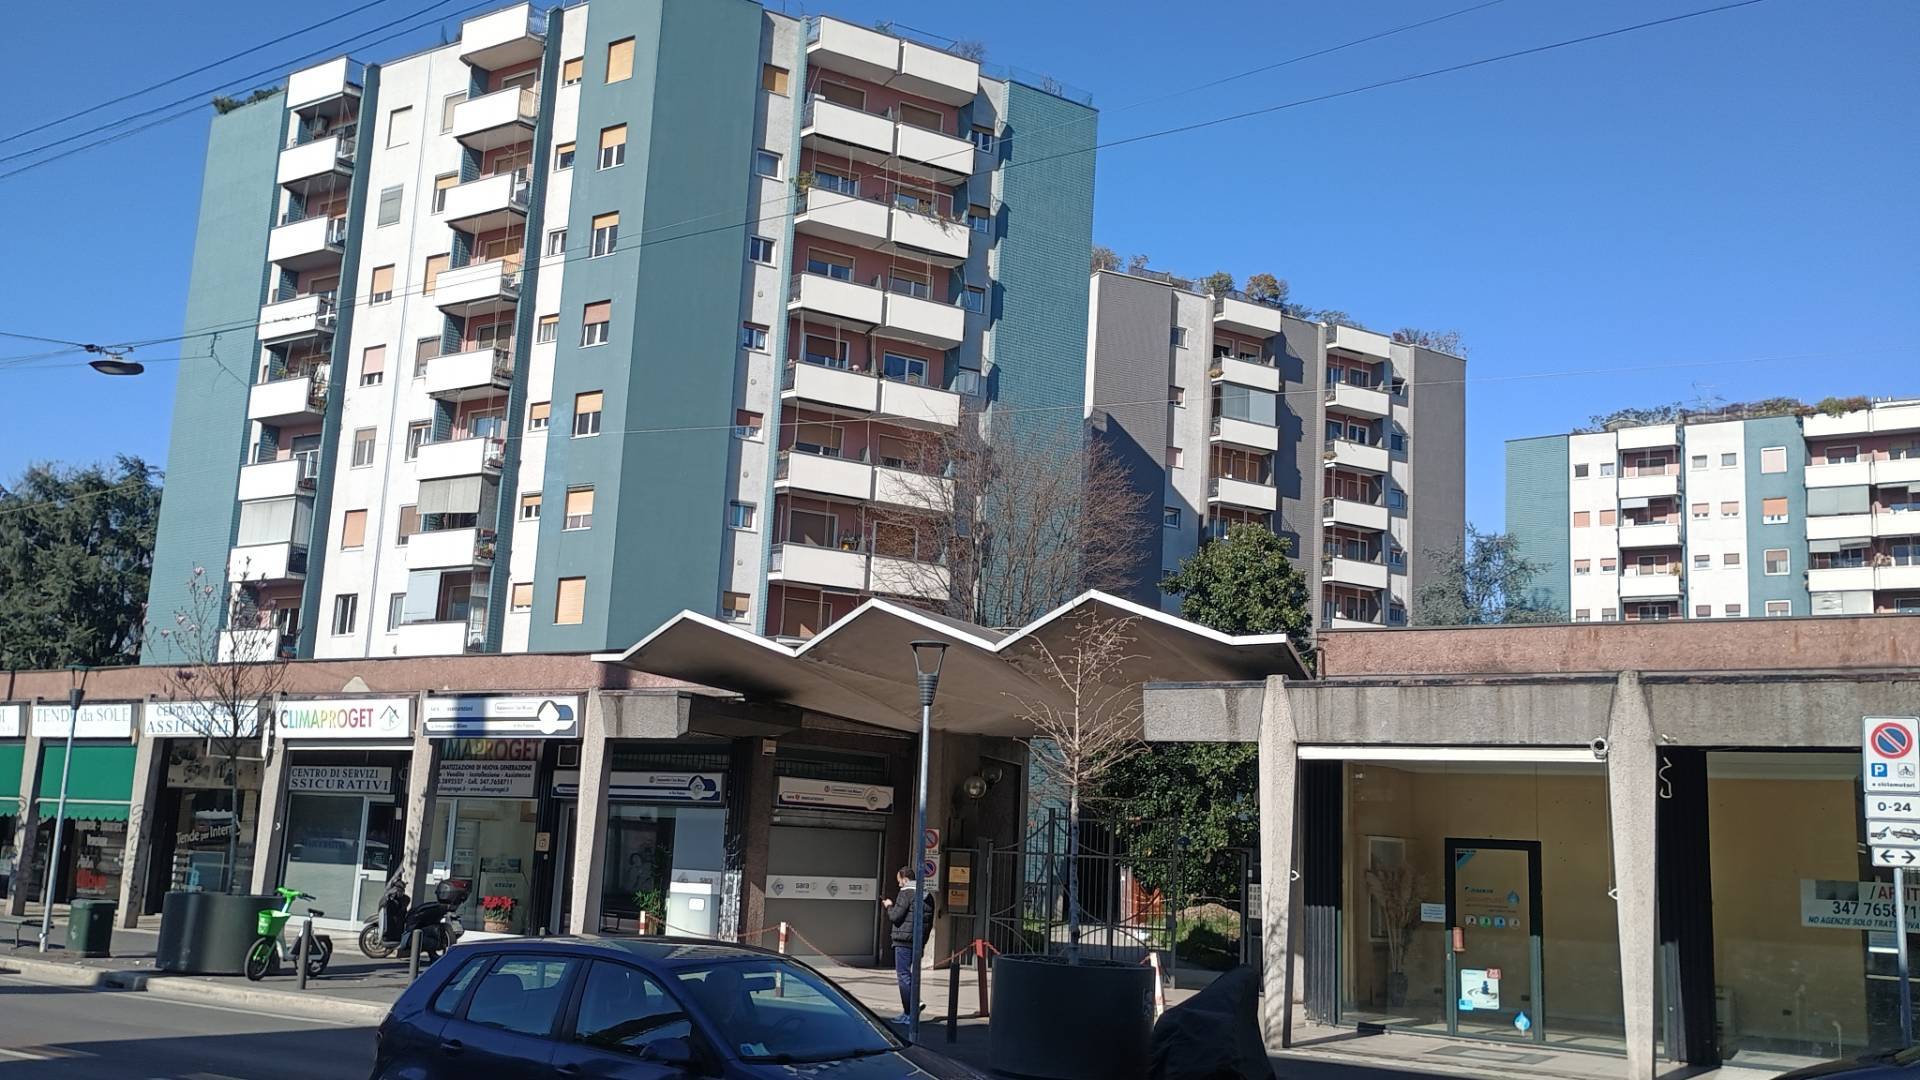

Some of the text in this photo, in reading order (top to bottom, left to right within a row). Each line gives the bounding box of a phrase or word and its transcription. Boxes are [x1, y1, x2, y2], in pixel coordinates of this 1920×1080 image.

[80, 708, 94, 721] da
[96, 707, 129, 721] SOLE
[280, 708, 374, 728] CLIMAPROGET
[291, 768, 379, 779] CENTRO DI SERVIZI
[176, 829, 200, 845] Tende
[1832, 901, 1859, 915] 347
[1808, 915, 1819, 923] NO
[1820, 916, 1851, 926] AGENZIE
[1853, 918, 1873, 927] SOLO
